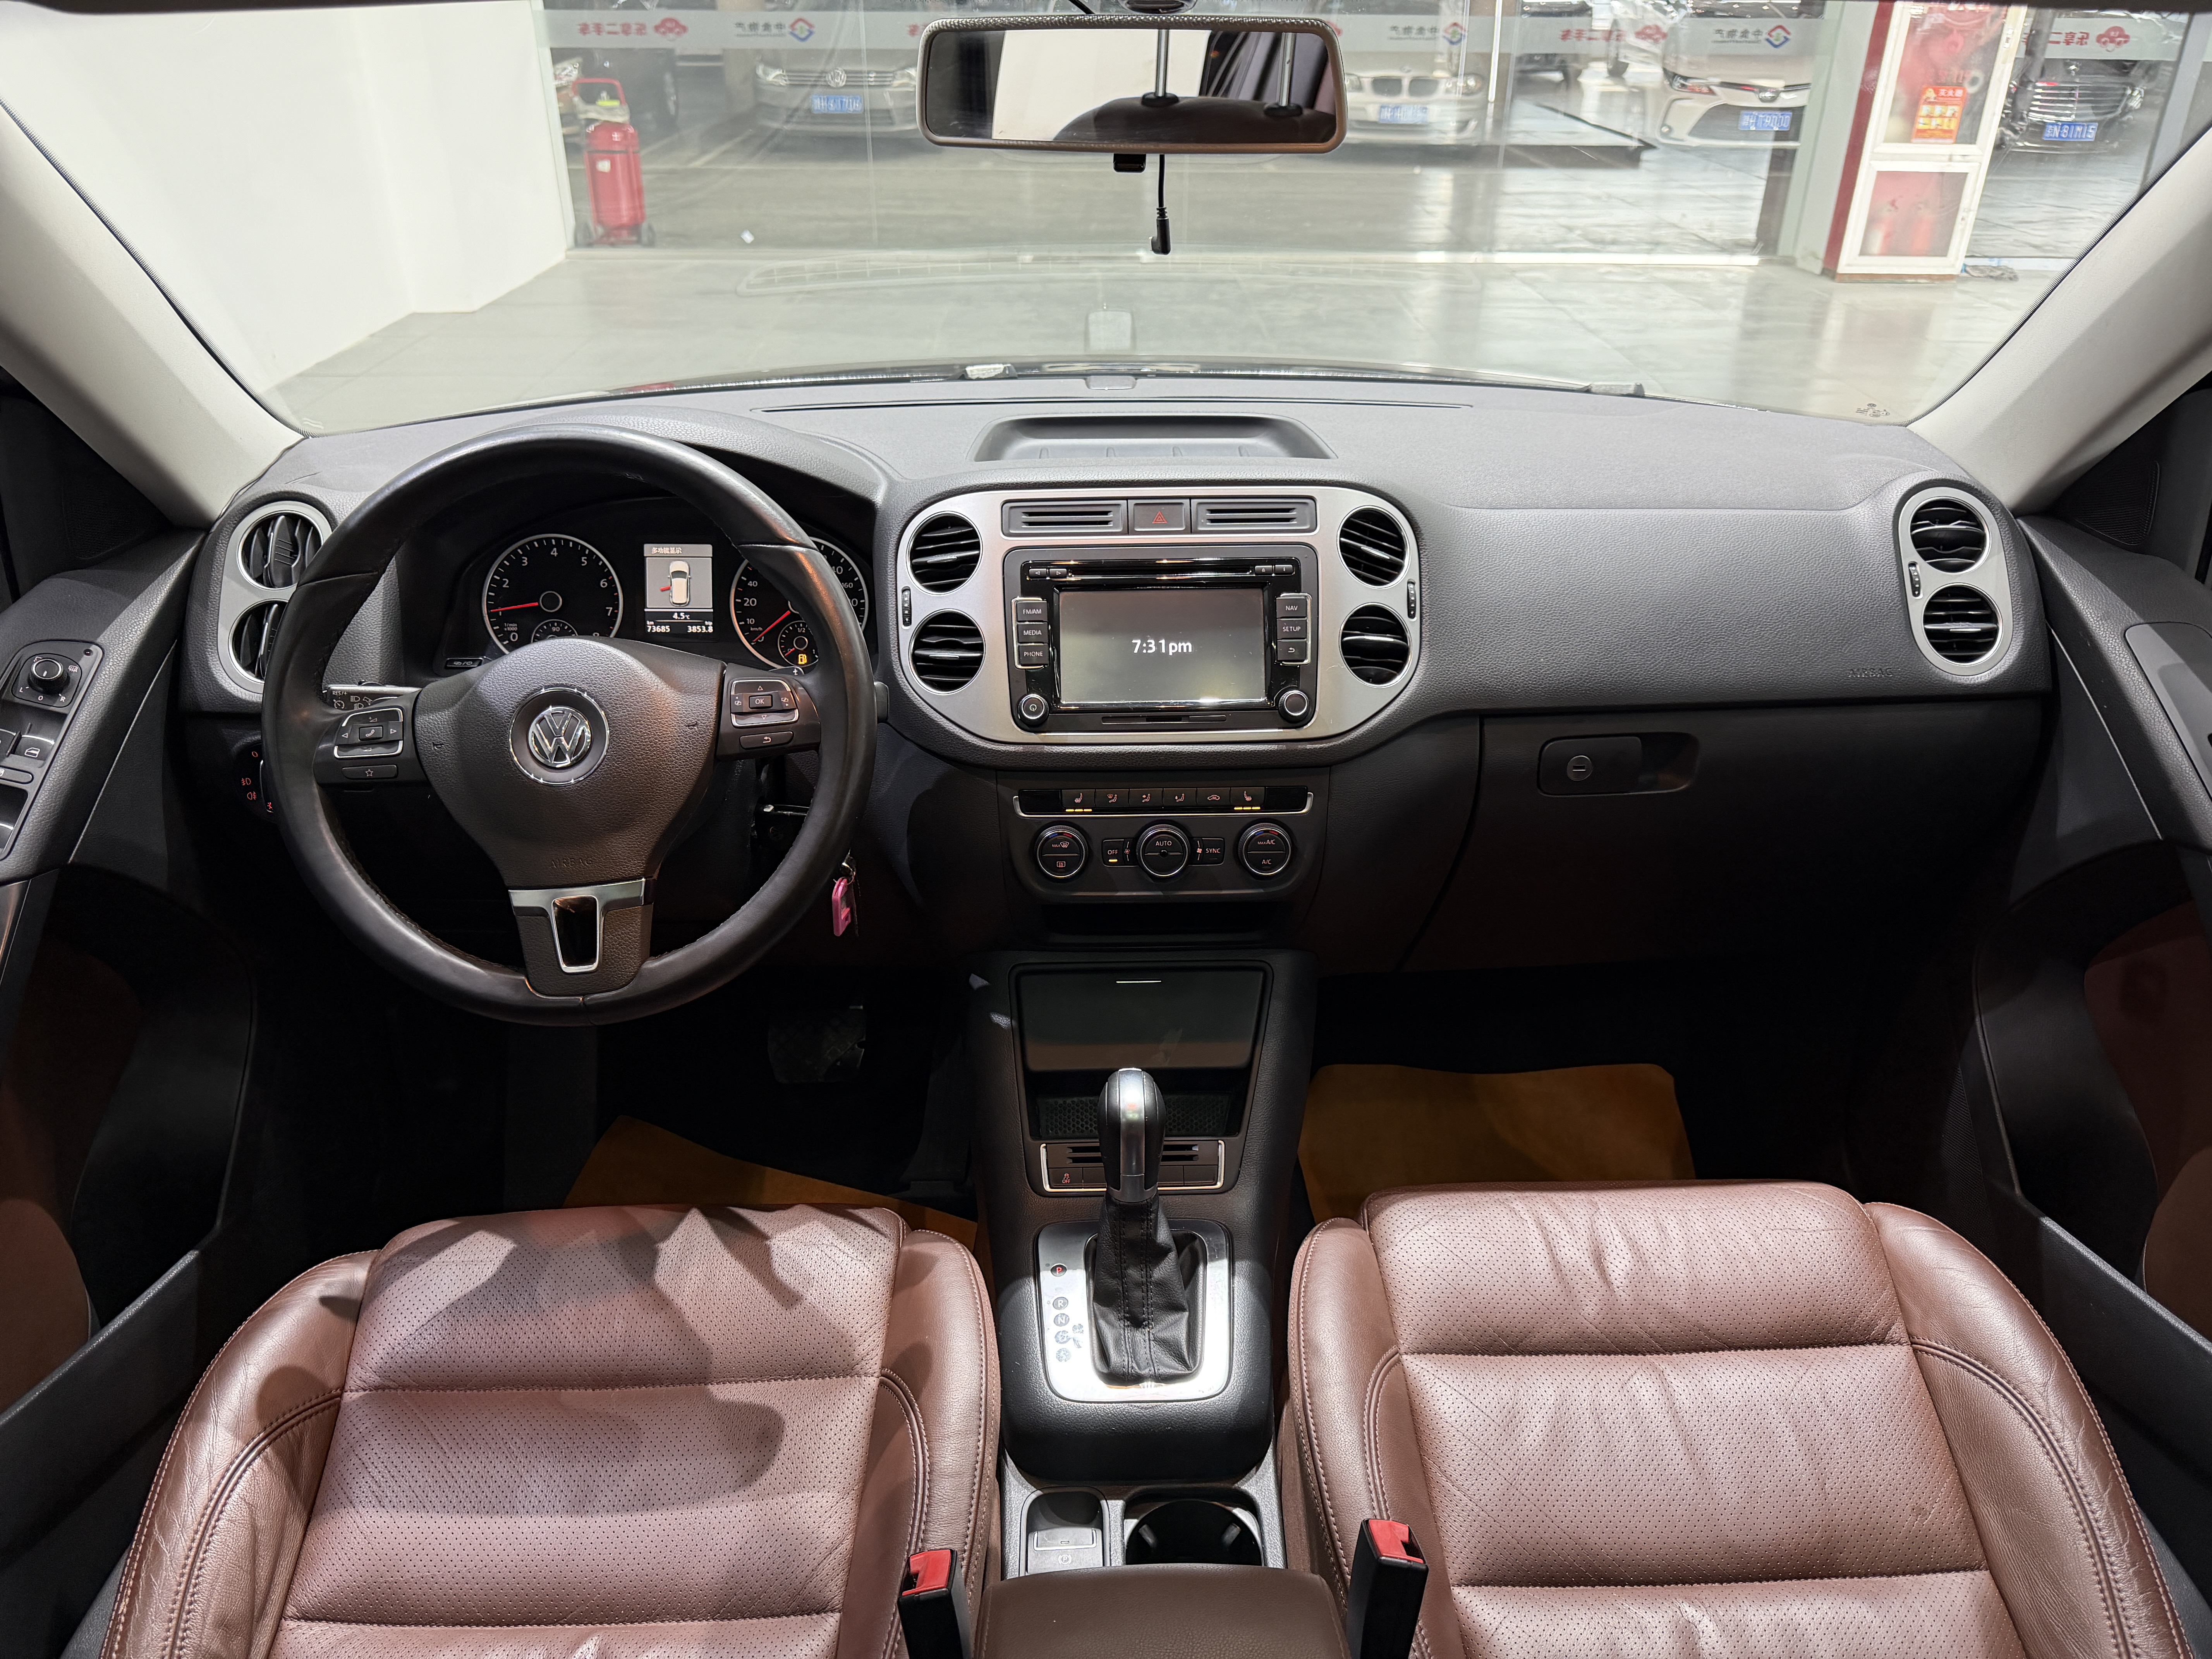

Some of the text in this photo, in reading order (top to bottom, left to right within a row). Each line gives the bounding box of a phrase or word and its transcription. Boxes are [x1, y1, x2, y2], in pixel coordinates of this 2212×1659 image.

[551, 548, 558, 556] 4
[522, 556, 528, 566] 3
[581, 556, 587, 566] 5
[503, 579, 509, 588] 2
[600, 579, 608, 588] 6
[744, 598, 757, 606] 20
[606, 607, 613, 616] 7
[510, 633, 518, 641] 0
[1848, 668, 1893, 678] AIRBAG
[549, 856, 592, 868] AIRBAG
[1058, 1299, 1064, 1307] R
